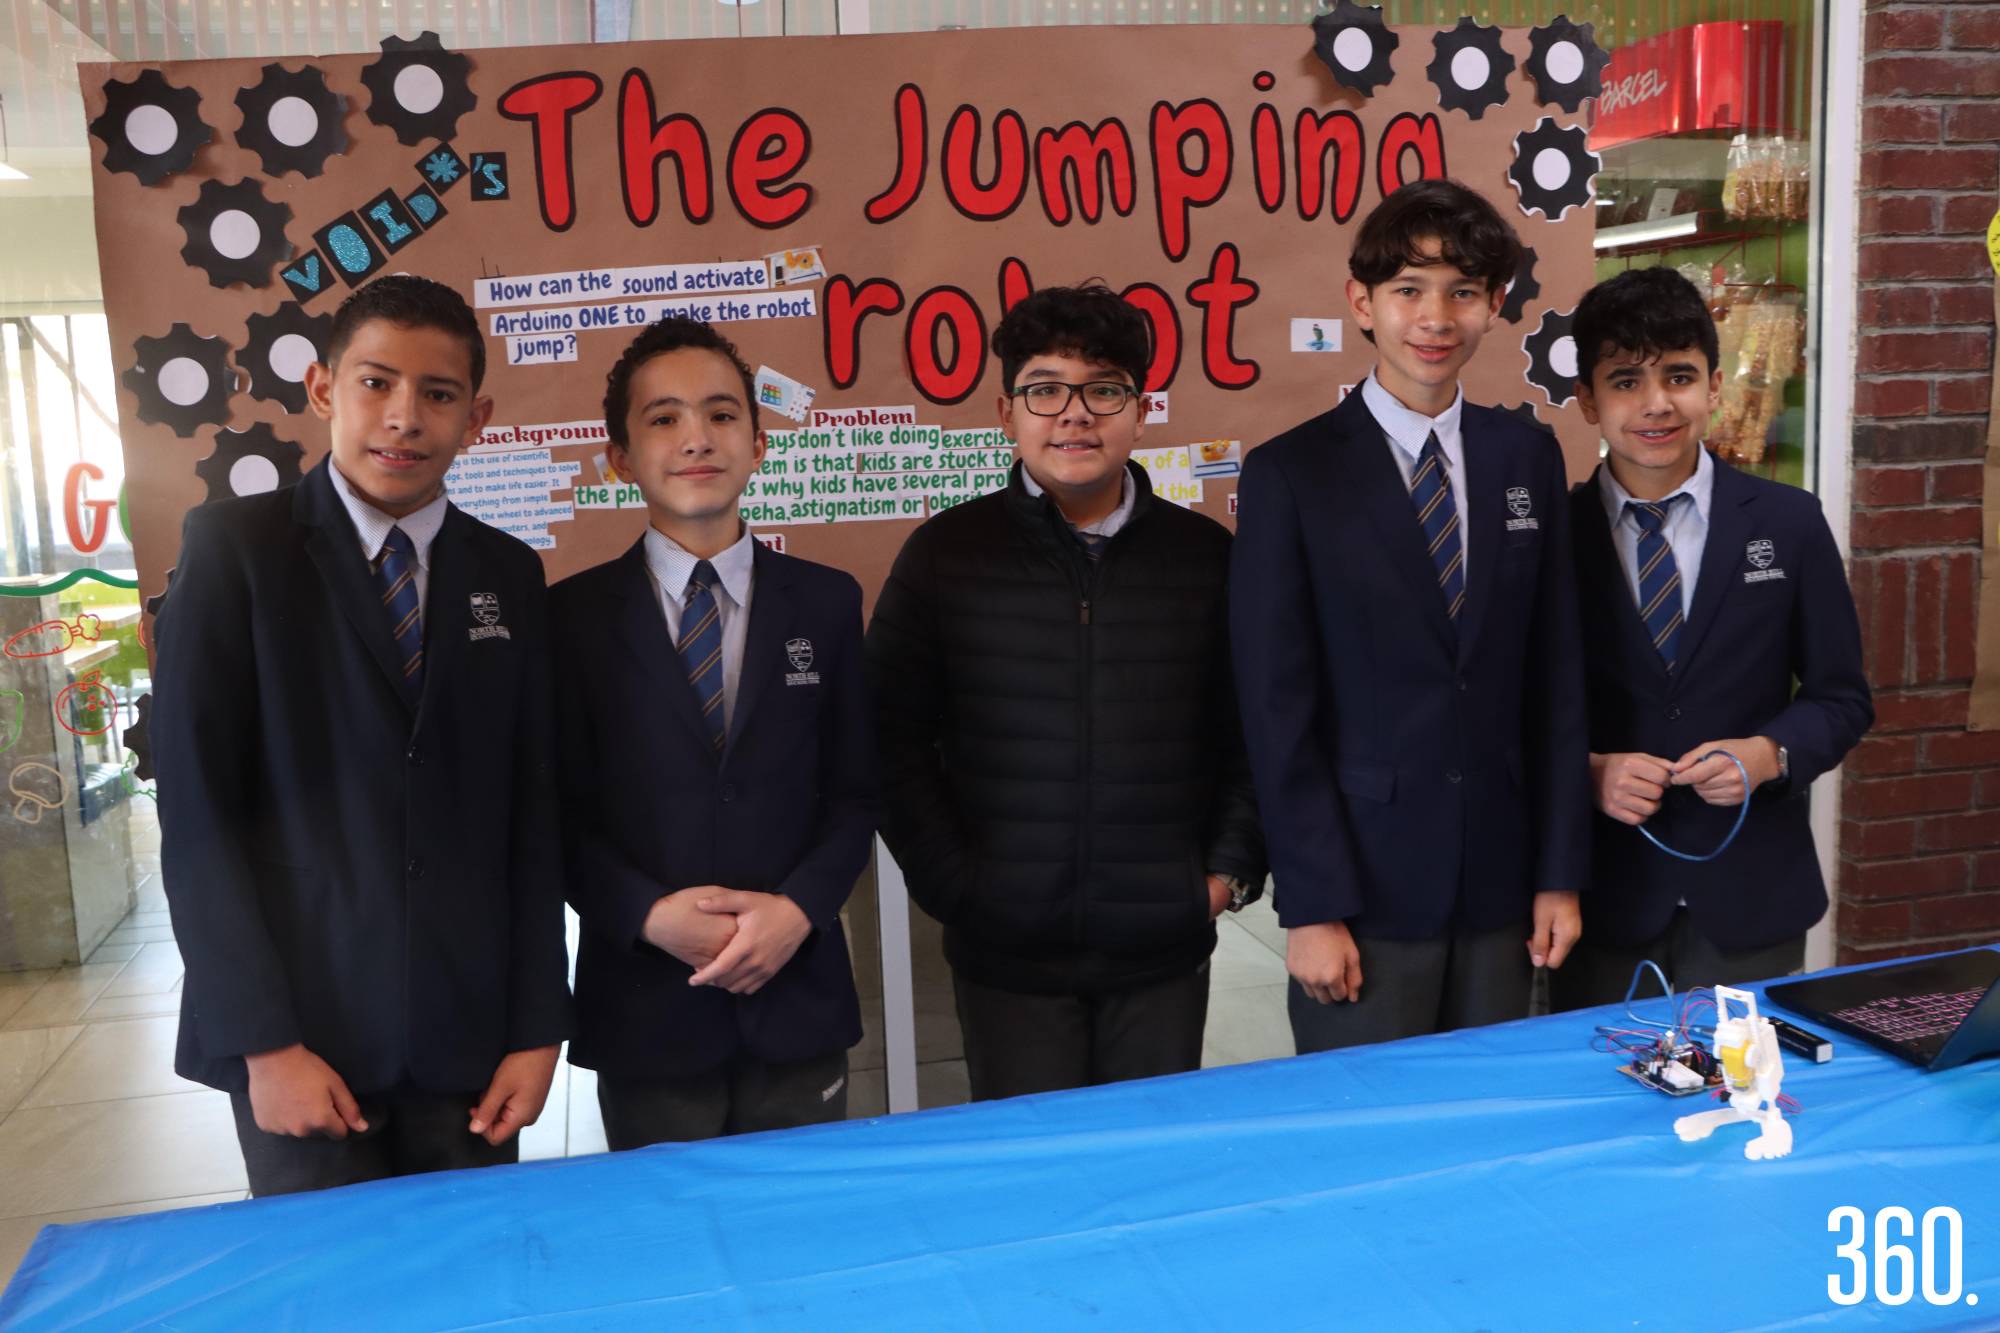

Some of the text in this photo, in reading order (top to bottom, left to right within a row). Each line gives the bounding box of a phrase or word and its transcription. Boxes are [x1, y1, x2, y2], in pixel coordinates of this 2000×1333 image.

[1600, 68, 1668, 116] BARCEL
[497, 67, 813, 232] The
[490, 267, 765, 301] How can the sound activate
[495, 297, 812, 334] Arduino ONE to make the robot
[514, 334, 577, 363] jump?
[814, 410, 913, 427] Problem
[474, 424, 606, 446] ackgroun
[798, 428, 845, 448] don't
[851, 427, 884, 446] like
[889, 425, 939, 450] doing
[471, 457, 484, 465] the
[503, 454, 511, 462] of
[513, 451, 549, 461] scientific
[794, 455, 807, 473] is
[812, 452, 855, 472] that
[861, 452, 896, 471] kids
[902, 454, 933, 470] are
[939, 450, 987, 469] stuck
[992, 449, 1012, 467] to
[1155, 451, 1175, 469] of
[1178, 453, 1190, 468] a
[464, 471, 484, 480] tools
[486, 470, 500, 478] and
[503, 466, 546, 477] techniques
[548, 465, 557, 473] to
[559, 464, 579, 472] solve
[458, 486, 472, 494] and
[474, 485, 483, 493] to
[485, 483, 506, 491] make
[509, 481, 522, 489] life
[576, 484, 609, 505] the
[762, 477, 804, 499] why
[811, 474, 846, 494] kids
[853, 474, 897, 492] have
[902, 470, 967, 489] several
[1169, 482, 1199, 500] the
[502, 496, 521, 506] from
[523, 494, 548, 504] simple
[902, 498, 922, 514] or
[481, 512, 495, 520] the
[497, 508, 521, 518] wheel
[523, 509, 532, 517] to
[534, 505, 572, 516] advanced
[532, 521, 547, 530] and
